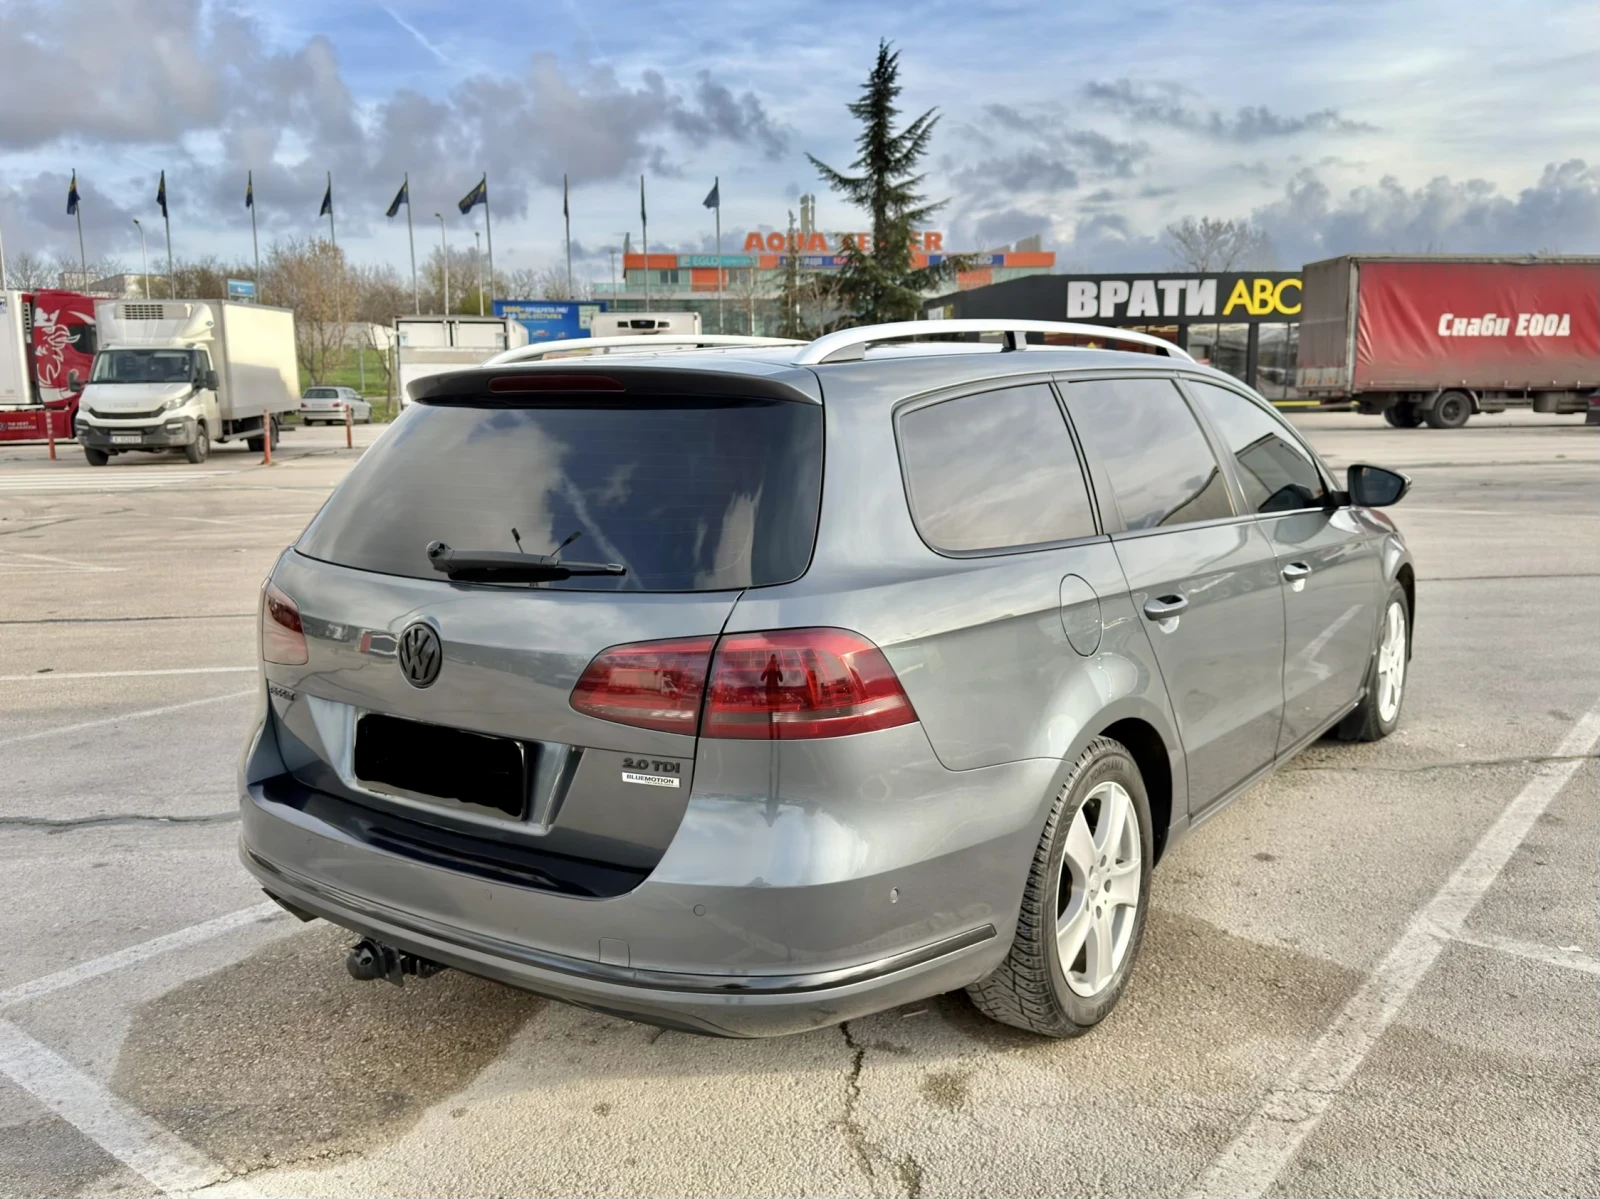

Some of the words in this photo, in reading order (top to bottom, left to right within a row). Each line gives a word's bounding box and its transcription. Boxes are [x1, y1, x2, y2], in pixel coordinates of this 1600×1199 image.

[744, 231, 828, 252] AQUA
[841, 232, 943, 251] CEER
[692, 255, 719, 267] EGLO
[1066, 279, 1217, 318] ВРАТИ
[1222, 278, 1303, 315] ABC
[1438, 313, 1510, 337] Снаби
[1514, 313, 1571, 337] ЕООД
[622, 757, 649, 770] 2.0
[652, 760, 681, 774] TDI
[626, 774, 675, 784] BLUEMOTION
